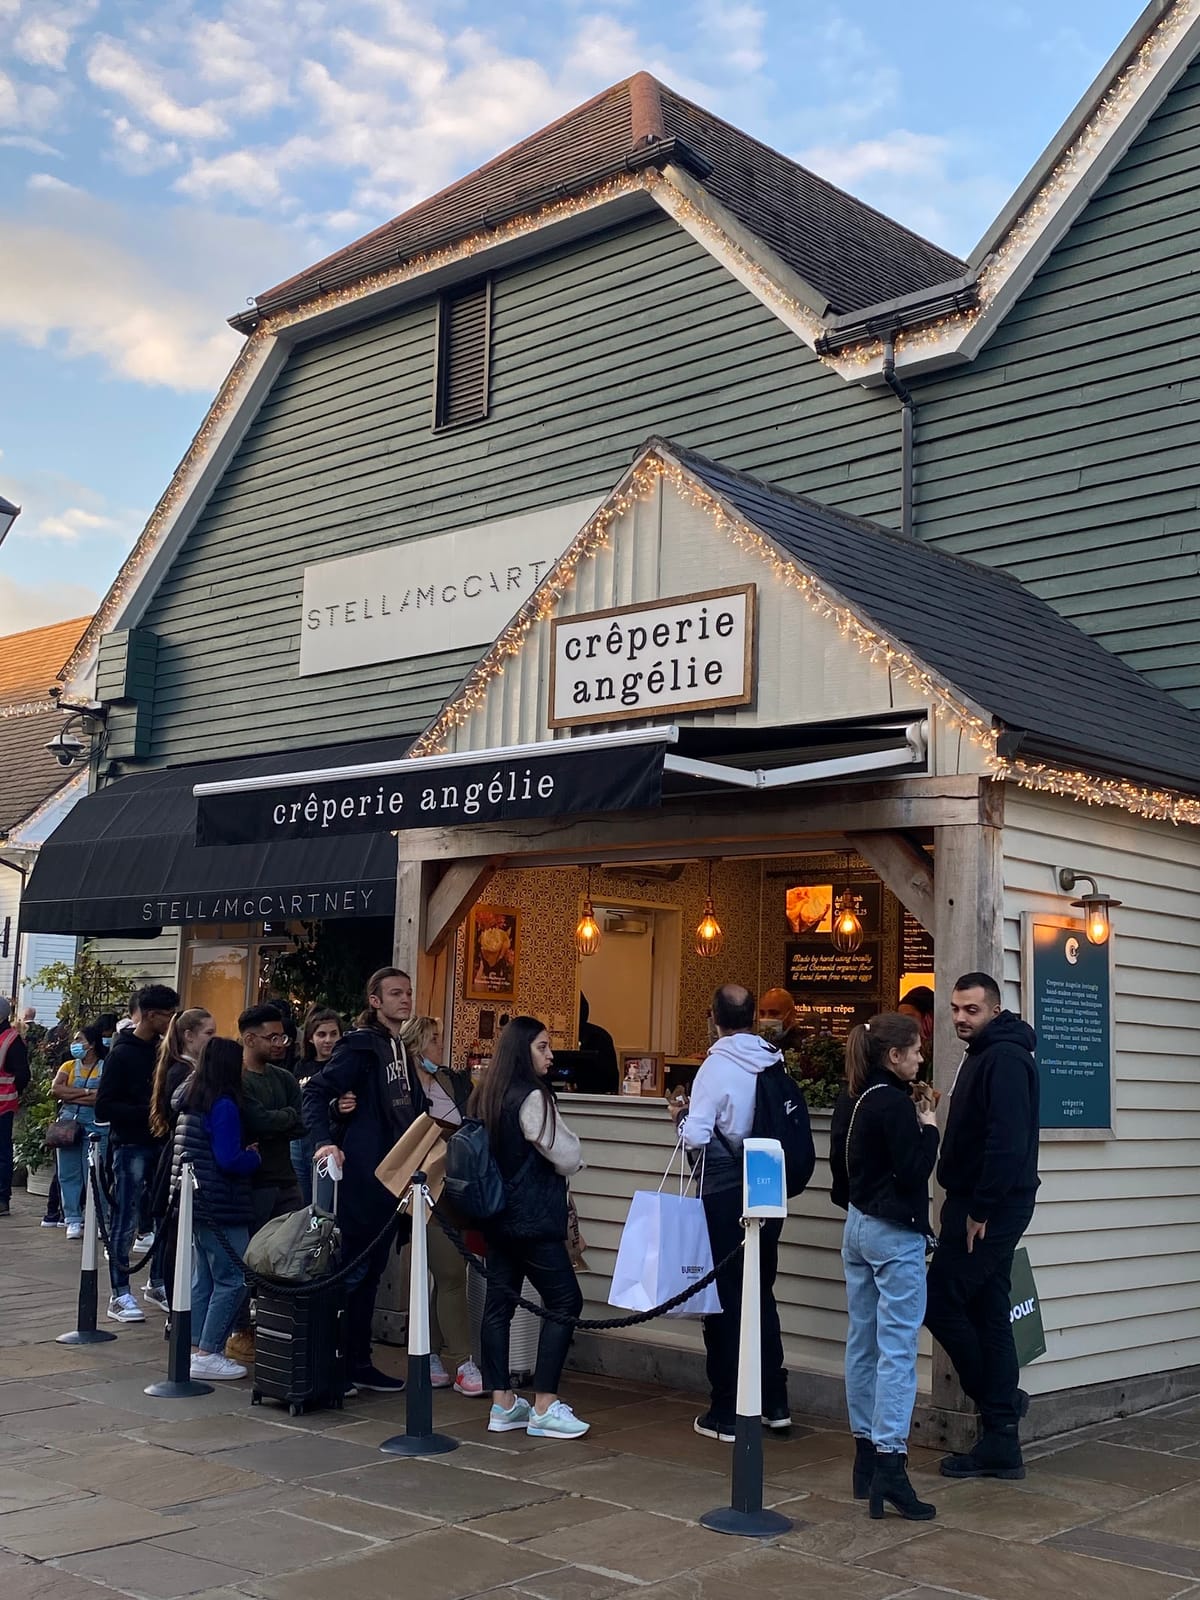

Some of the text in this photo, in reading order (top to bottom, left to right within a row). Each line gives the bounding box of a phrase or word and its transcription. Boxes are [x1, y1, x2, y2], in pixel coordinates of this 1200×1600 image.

[565, 607, 734, 661] crêperie
[573, 656, 723, 705] angélie
[273, 769, 554, 827] crêperie angélie
[792, 954, 810, 962] Made
[812, 954, 818, 964] by
[820, 954, 834, 962] hand
[835, 956, 851, 964] using
[812, 1005, 832, 1014] vegan
[756, 1177, 772, 1185] EXIT
